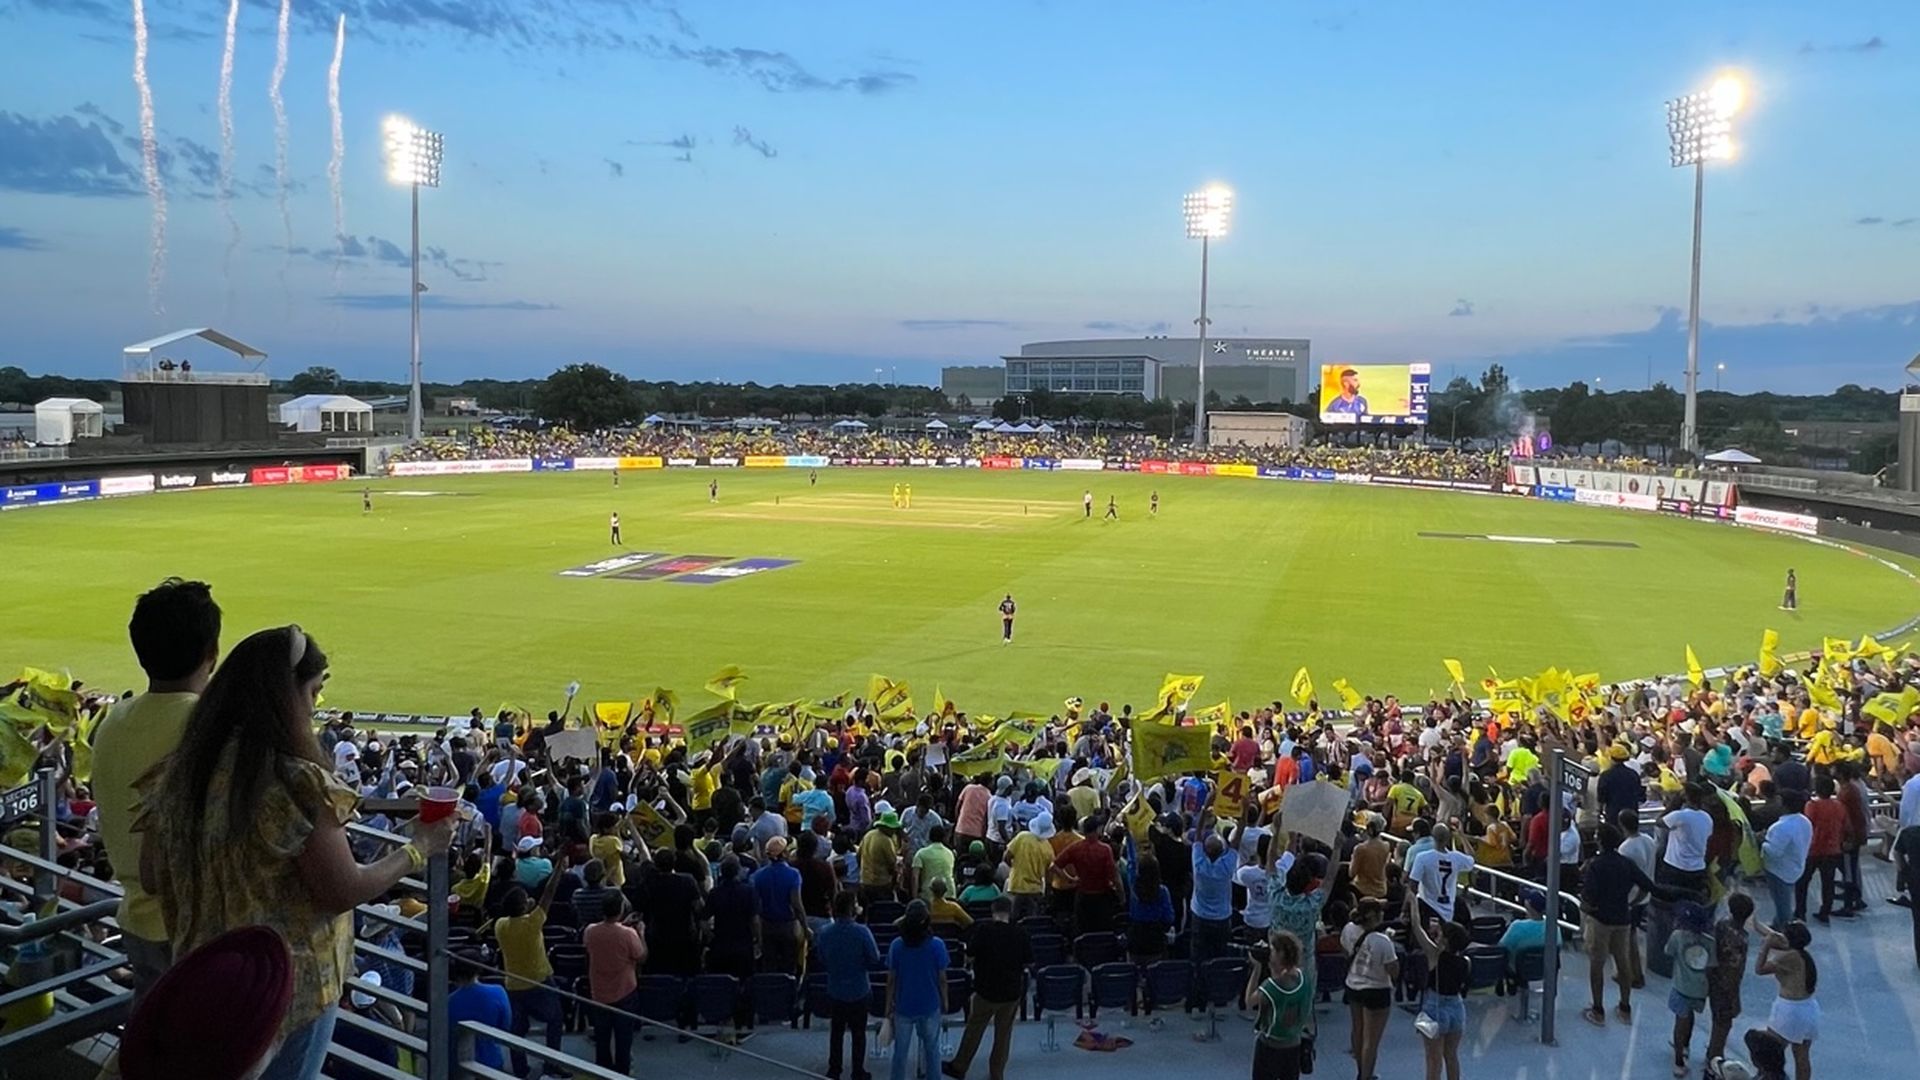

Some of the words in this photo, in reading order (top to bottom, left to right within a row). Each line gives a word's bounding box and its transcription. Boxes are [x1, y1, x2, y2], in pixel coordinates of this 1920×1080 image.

[1246, 349, 1295, 357] THEATRE
[160, 474, 197, 487] betway
[211, 471, 247, 483] betway
[1563, 772, 1582, 790] 106
[5, 784, 38, 804] SECTION
[1221, 777, 1242, 804] 4
[12, 794, 38, 815] 106
[1406, 797, 1415, 810] 7
[1439, 867, 1453, 895] 7
